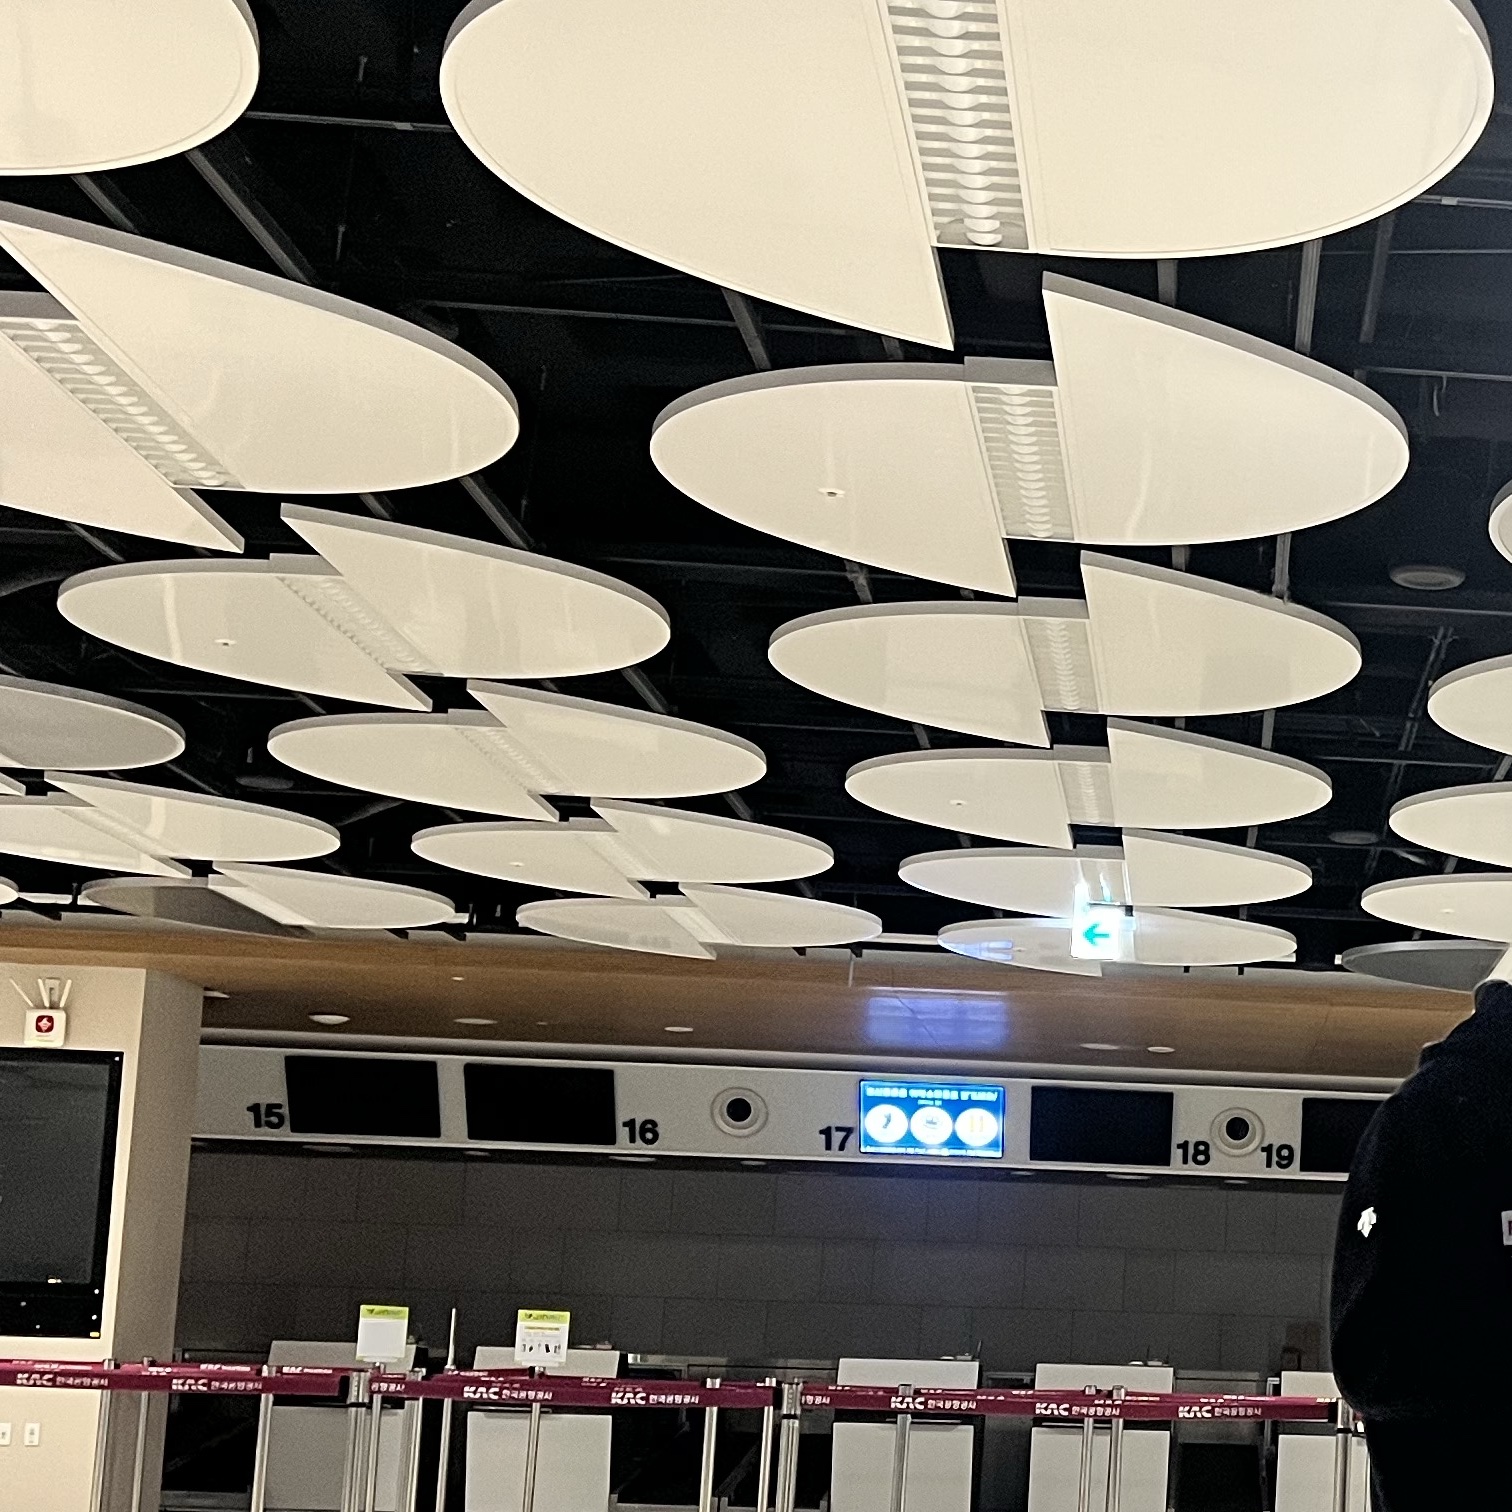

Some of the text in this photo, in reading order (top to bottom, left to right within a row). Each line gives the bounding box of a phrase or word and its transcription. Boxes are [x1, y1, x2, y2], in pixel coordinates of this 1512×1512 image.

[246, 1103, 285, 1129] 15
[622, 1118, 659, 1145] 16
[819, 1126, 854, 1151] 17
[1176, 1140, 1211, 1166] 18
[1261, 1143, 1295, 1169] 19
[16, 1373, 54, 1386] KAC
[172, 1379, 208, 1392] KAC
[463, 1386, 500, 1399] KAC
[611, 1392, 647, 1405] KAC
[891, 1396, 926, 1410] KAC
[1035, 1403, 1070, 1416] KAC
[1178, 1405, 1213, 1418] KAC
